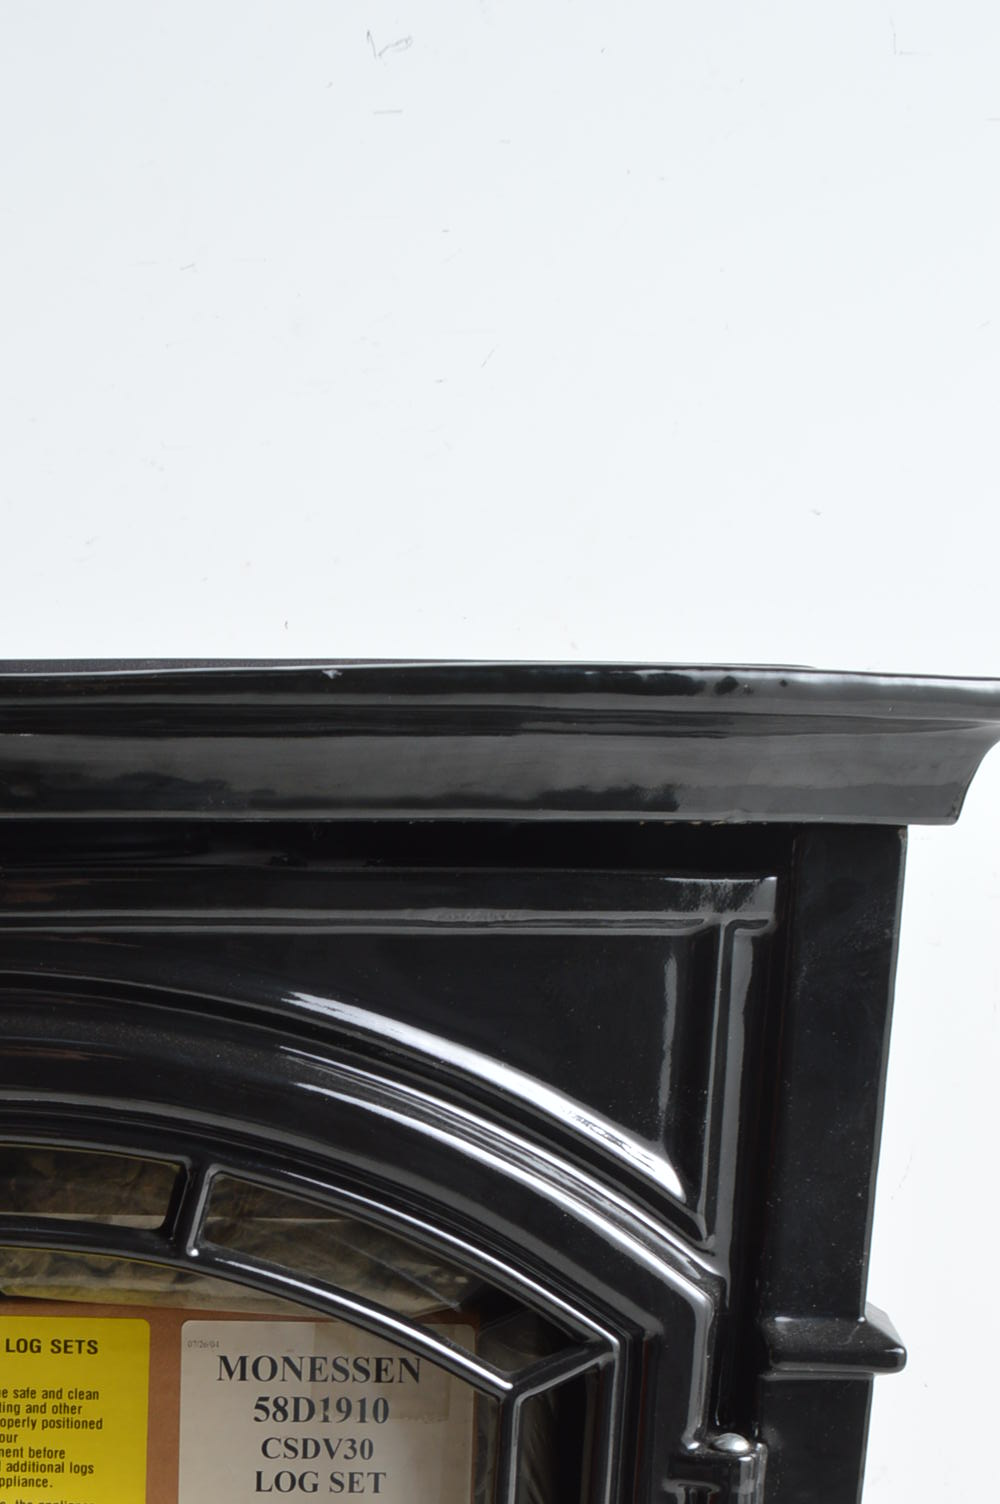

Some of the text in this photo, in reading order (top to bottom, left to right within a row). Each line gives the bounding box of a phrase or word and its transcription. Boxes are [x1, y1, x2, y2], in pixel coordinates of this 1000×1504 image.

[5, 1338, 42, 1354] LOG
[50, 1338, 98, 1355] SETS
[216, 1354, 421, 1384] MONESSEN
[13, 1387, 37, 1399] safe
[41, 1388, 63, 1400] and
[67, 1388, 99, 1401] clean
[25, 1402, 47, 1414] and
[51, 1402, 82, 1415] other
[253, 1396, 390, 1424] 58D1910
[41, 1417, 103, 1430] positioned
[28, 1447, 65, 1459] before
[260, 1437, 375, 1461] CSDV30
[6, 1461, 65, 1473] additional
[69, 1462, 94, 1476] logs
[255, 1470, 387, 1494] LOG SET
